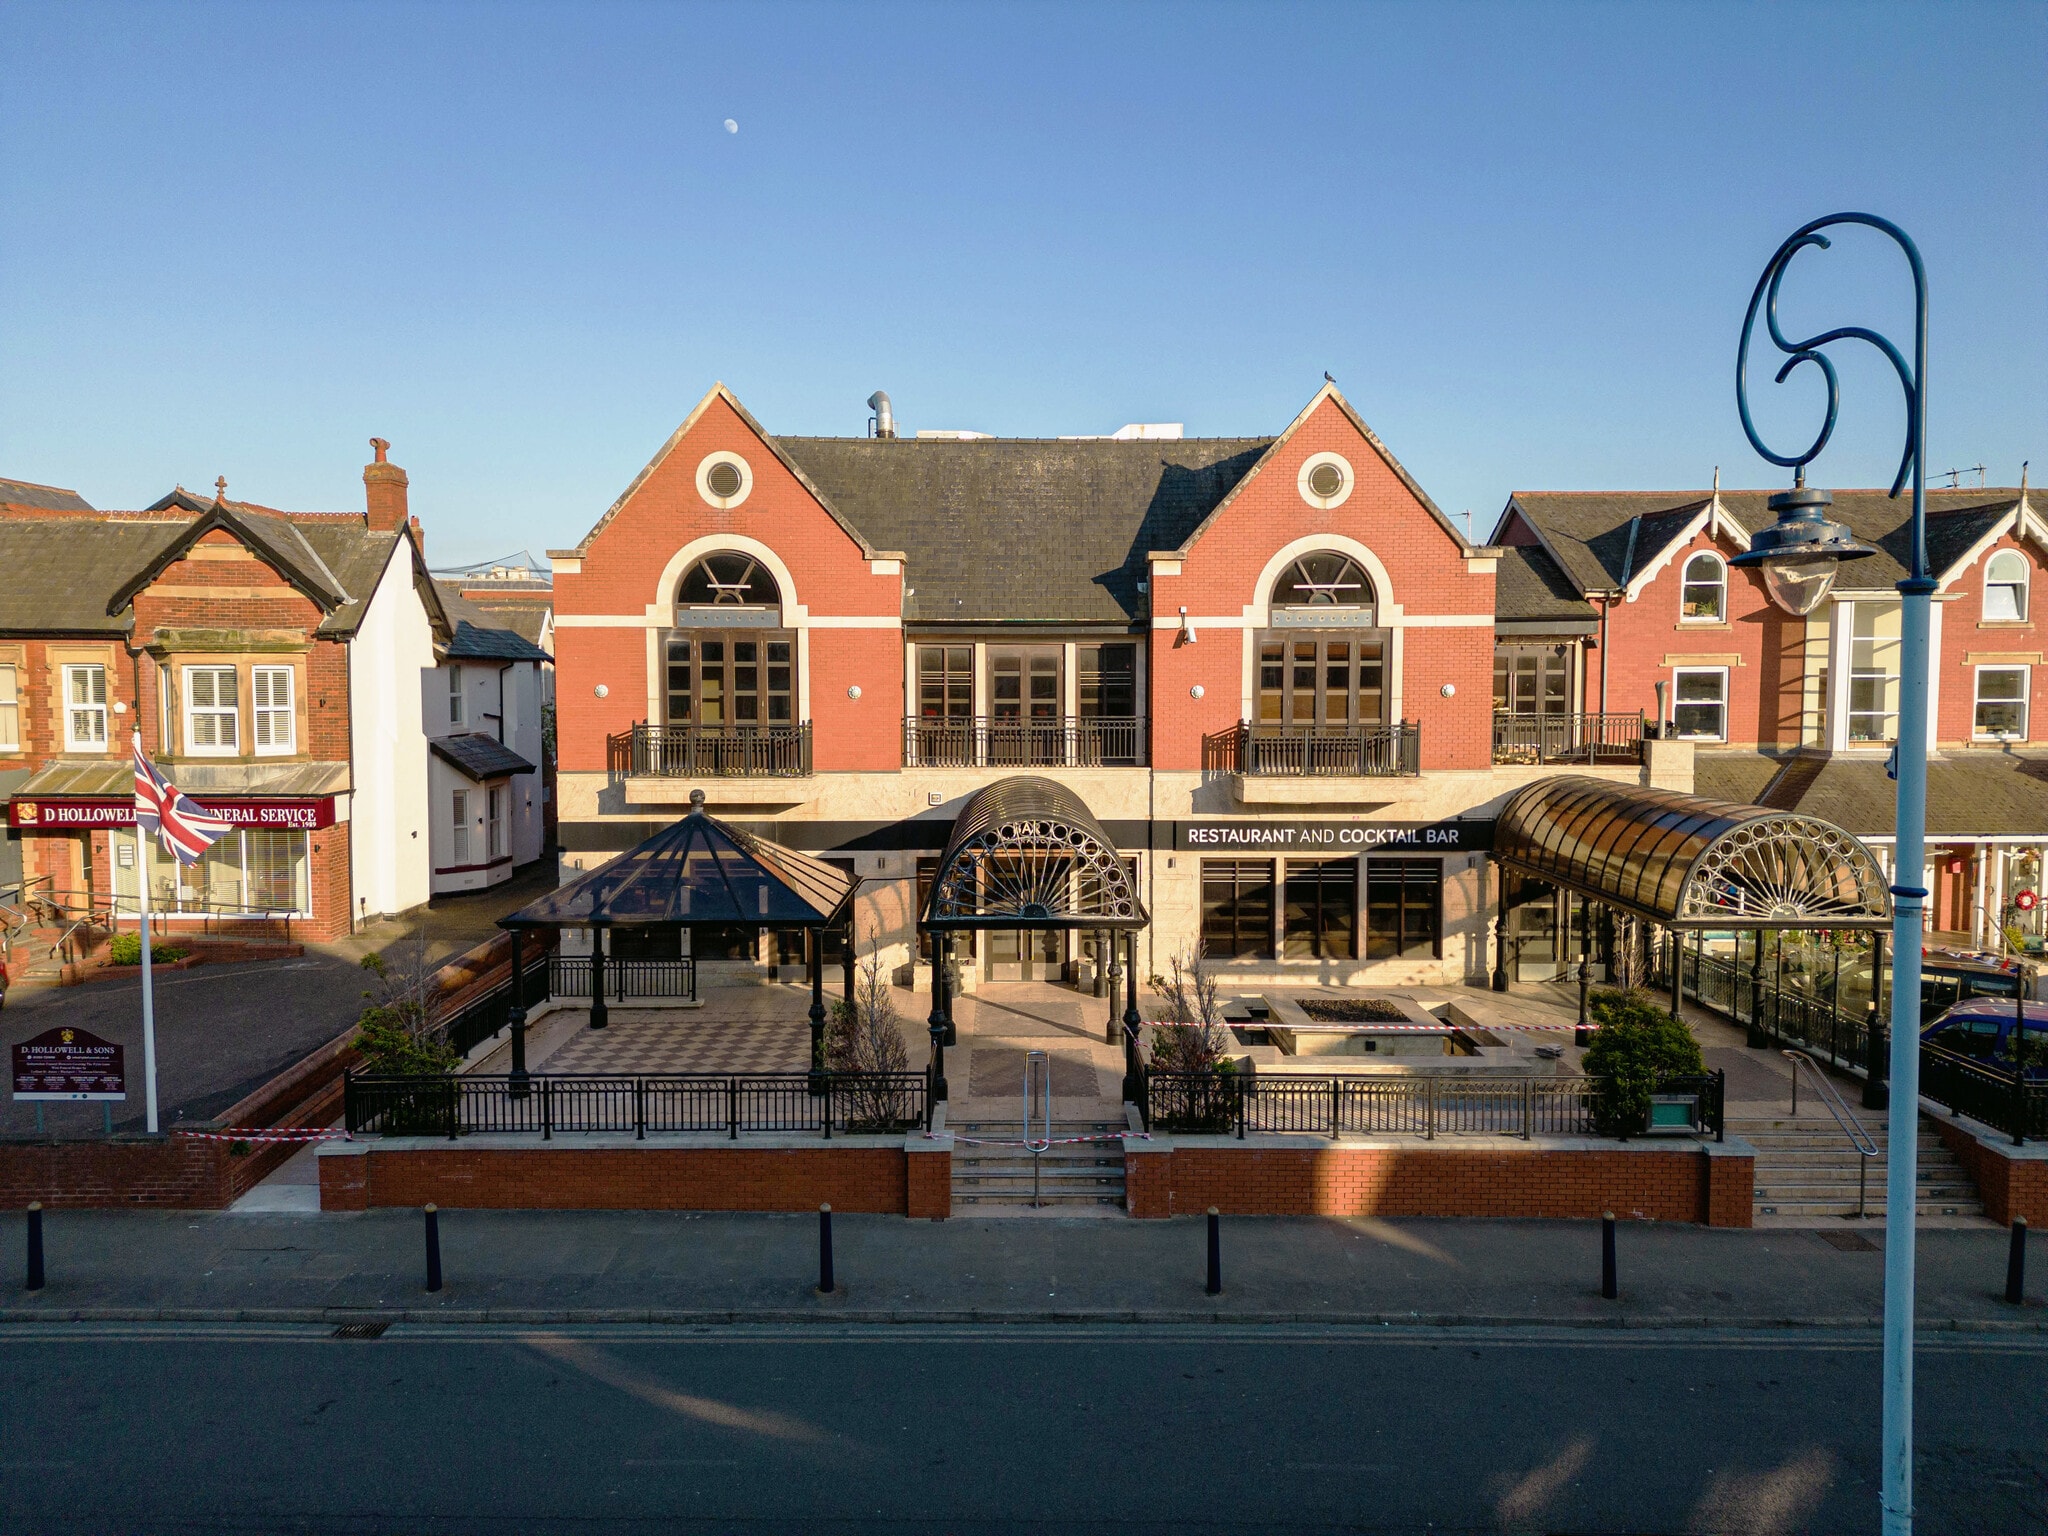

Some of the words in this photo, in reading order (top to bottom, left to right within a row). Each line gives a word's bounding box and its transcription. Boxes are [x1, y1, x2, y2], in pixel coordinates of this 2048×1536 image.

[44, 807, 56, 822] D
[205, 808, 258, 822] NERAL
[260, 808, 317, 822] SERVICE
[1188, 828, 1296, 843] RESTAURANT
[1300, 828, 1335, 843] AND
[1339, 828, 1421, 843] COCKTAIL
[1426, 828, 1459, 843] BAR
[31, 1046, 85, 1054] HOLLOWELL
[86, 1046, 92, 1054] &
[94, 1046, 115, 1054] SONS
